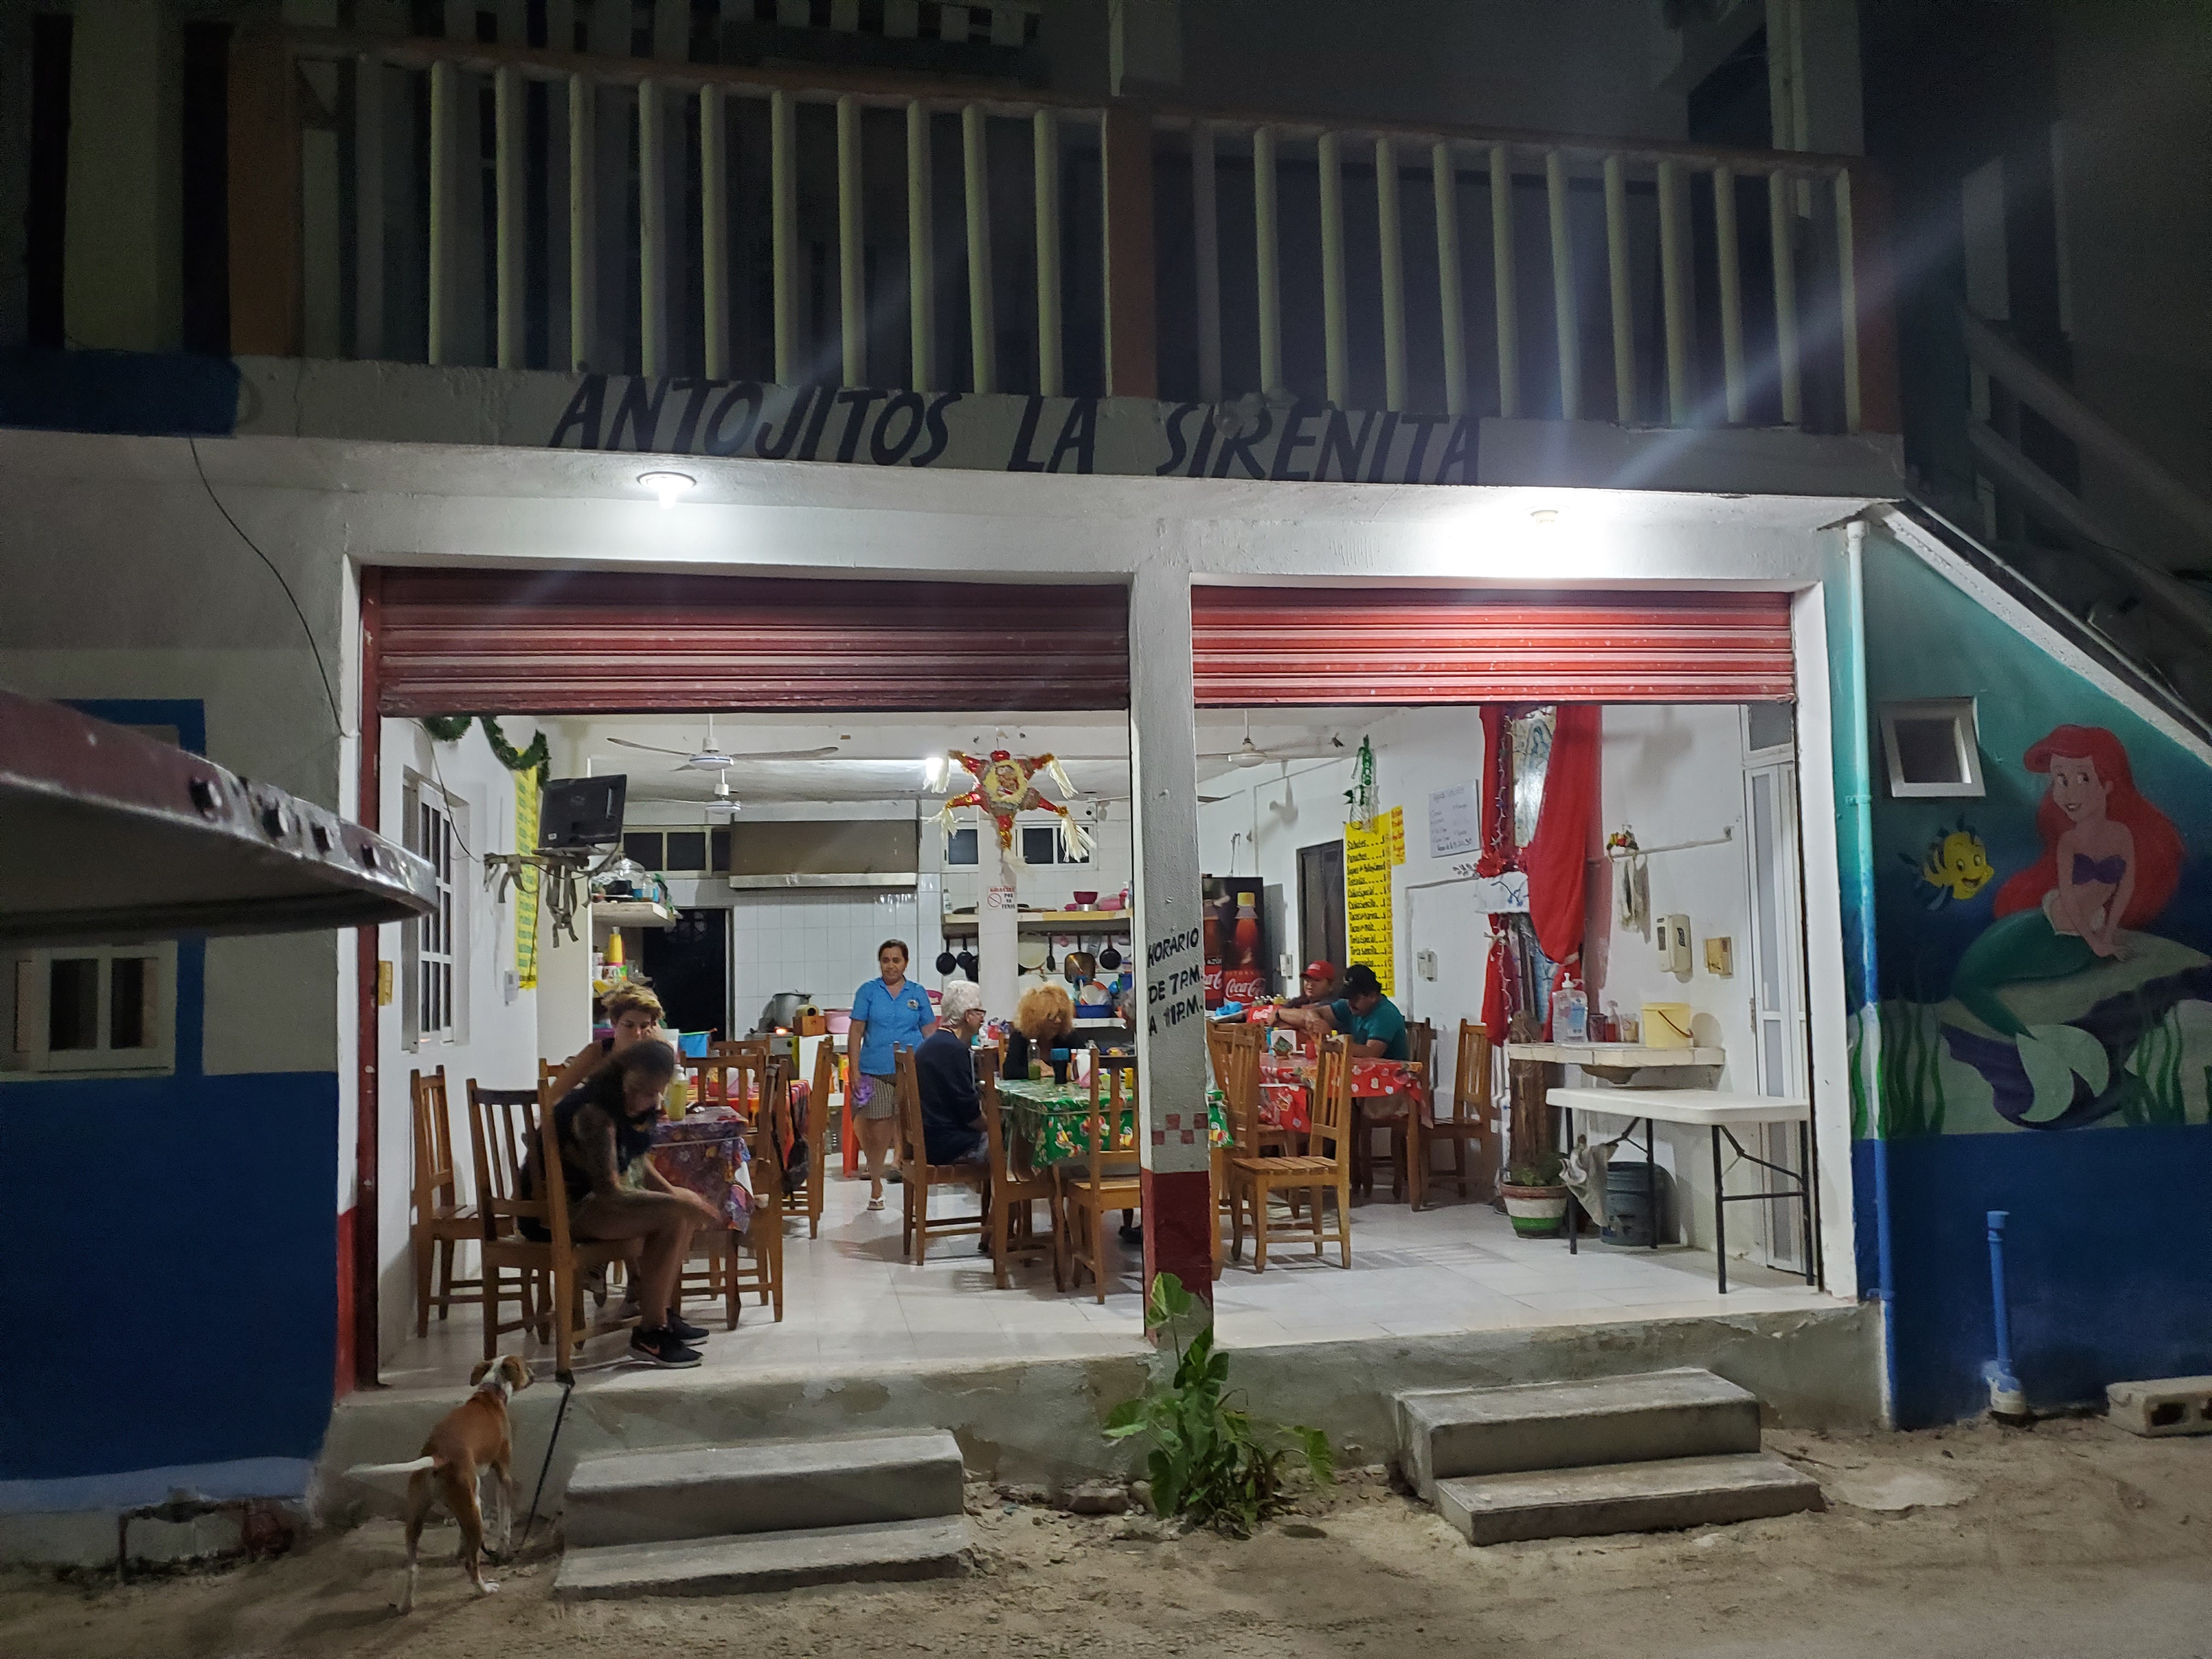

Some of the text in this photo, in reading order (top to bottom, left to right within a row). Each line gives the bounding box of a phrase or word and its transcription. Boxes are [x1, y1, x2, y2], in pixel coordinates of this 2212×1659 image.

[550, 374, 1480, 485] ANTOJITOS LA SIRENITA
[1147, 927, 1199, 968] HORARIO
[1148, 980, 1165, 1005] DE
[1225, 978, 1266, 998] Coca-Co
[1148, 1015, 1158, 1036] A
